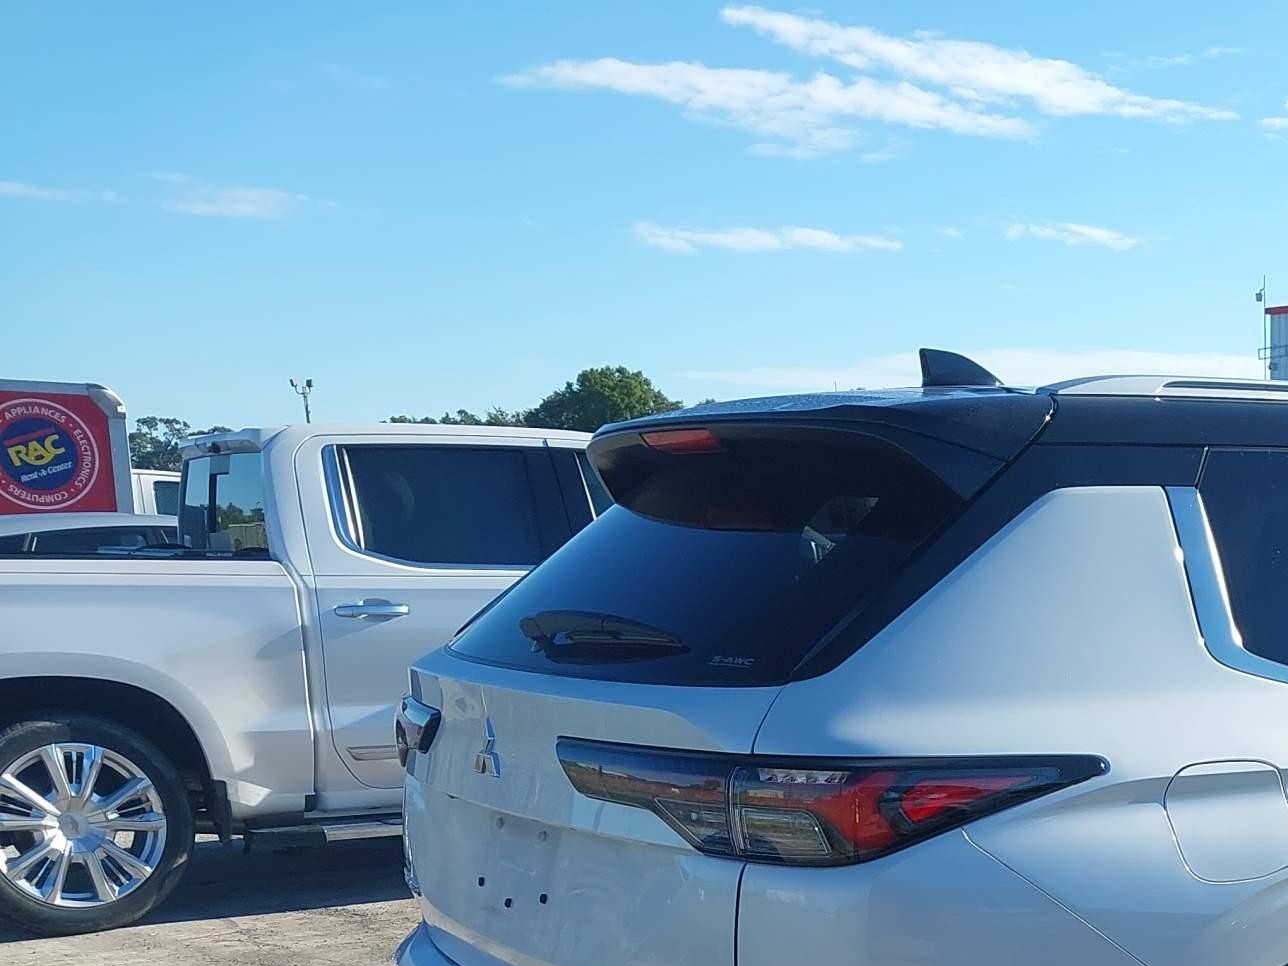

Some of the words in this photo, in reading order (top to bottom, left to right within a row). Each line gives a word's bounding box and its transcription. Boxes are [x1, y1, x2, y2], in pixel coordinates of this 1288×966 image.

[4, 405, 66, 423] APPLIANCES
[7, 434, 66, 467] RAC
[73, 428, 91, 488] ELECTRONICS
[7, 484, 68, 503] COMPUTERS
